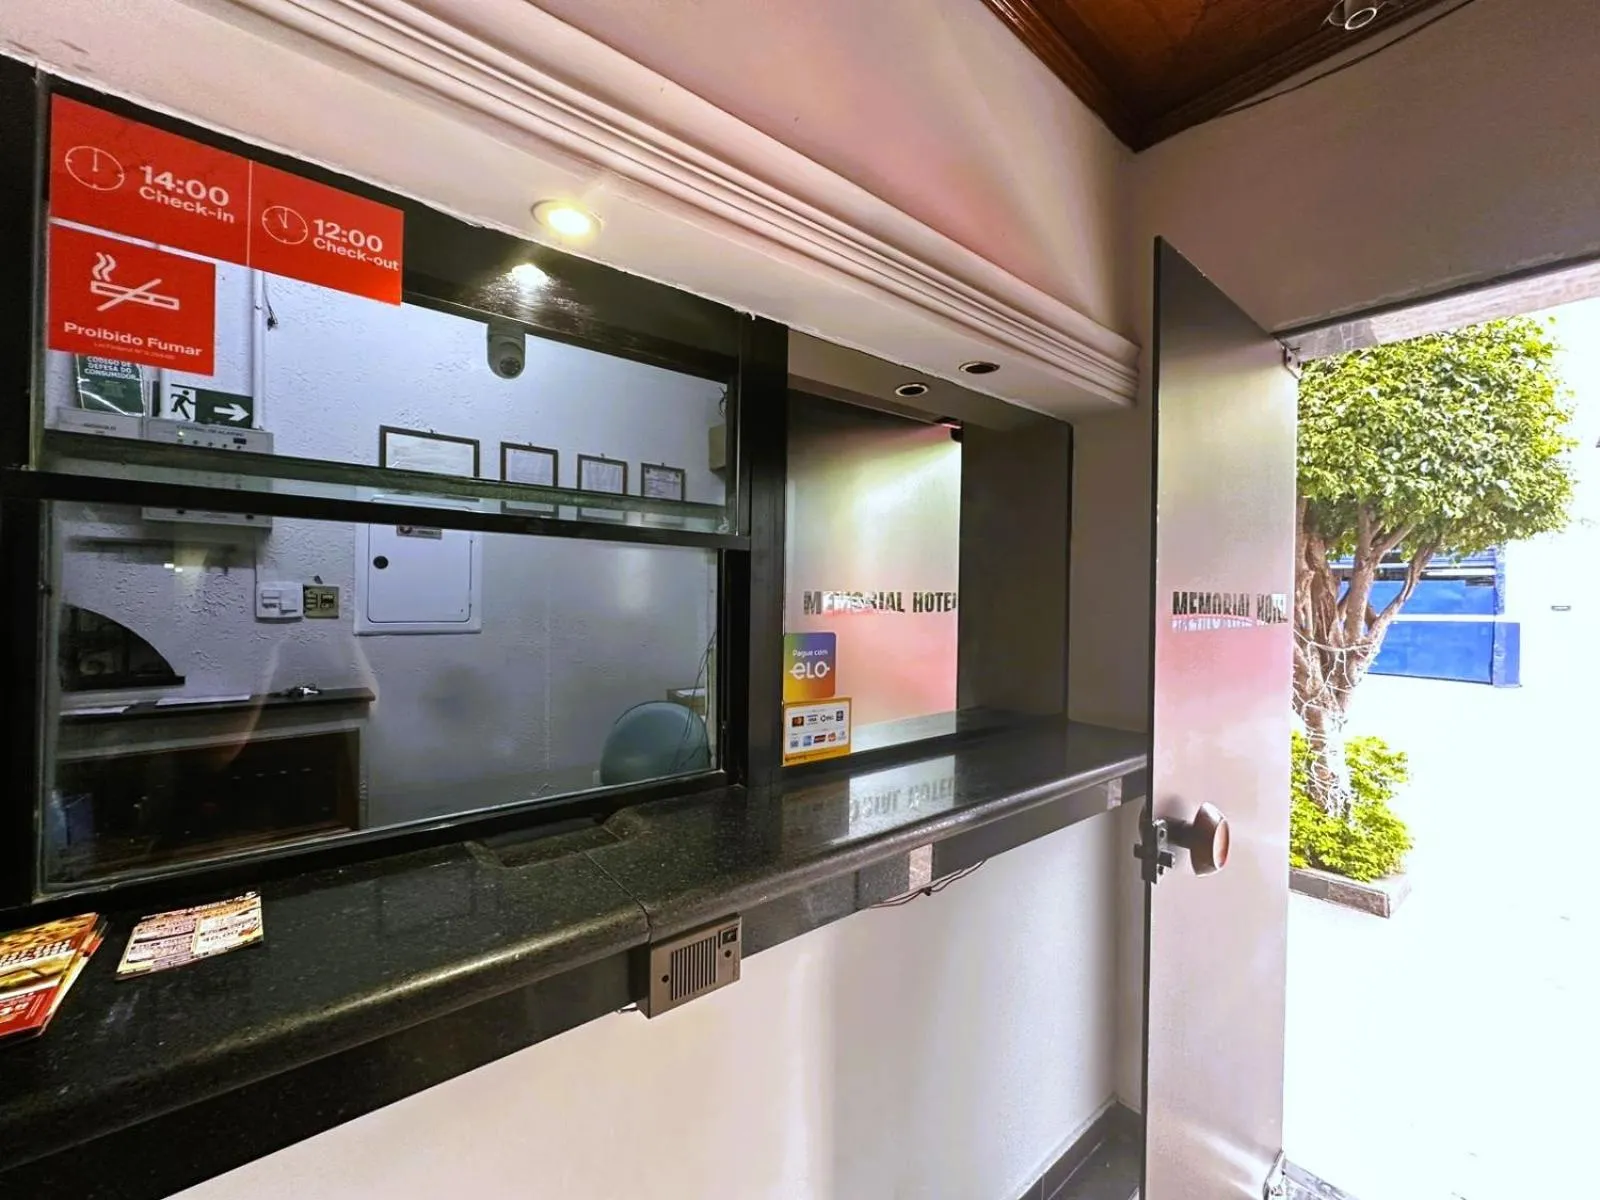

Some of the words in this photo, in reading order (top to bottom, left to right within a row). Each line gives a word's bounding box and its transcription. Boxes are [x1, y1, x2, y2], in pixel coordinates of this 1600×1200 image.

[139, 165, 230, 207] 14:00
[139, 185, 235, 224] Check-in
[313, 218, 383, 253] 12:00
[313, 236, 400, 271] Check-out
[63, 321, 144, 346] Proibido
[146, 336, 203, 357] Fumar
